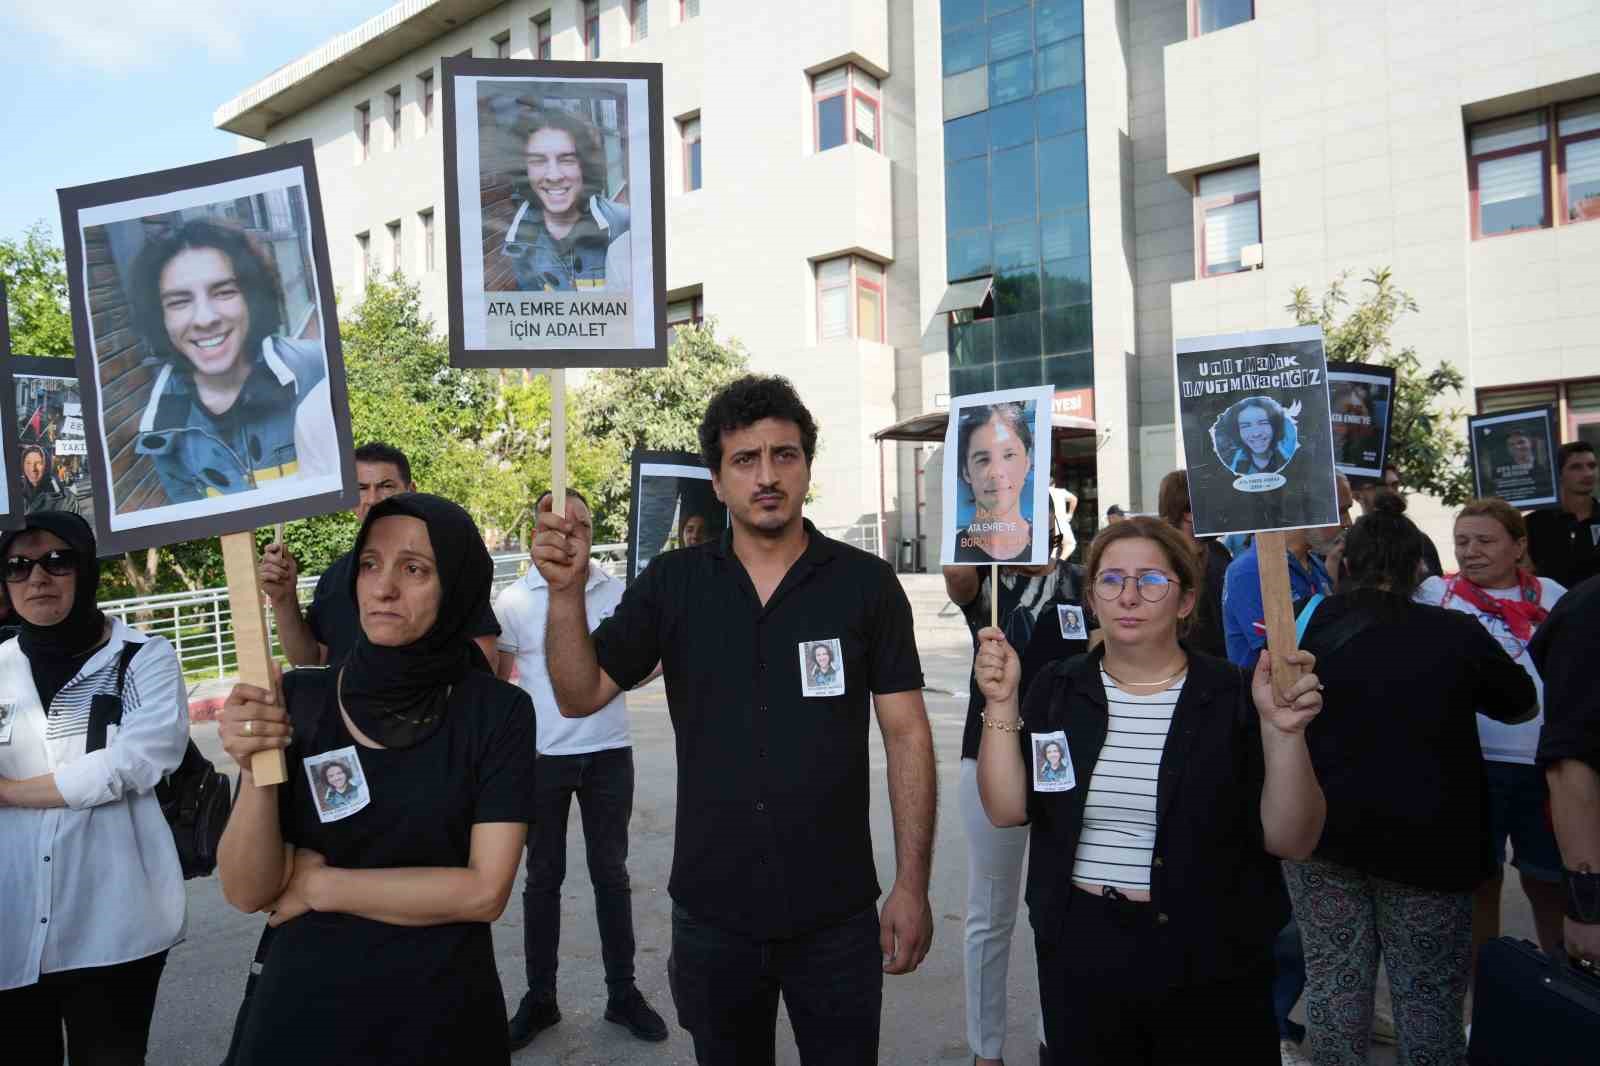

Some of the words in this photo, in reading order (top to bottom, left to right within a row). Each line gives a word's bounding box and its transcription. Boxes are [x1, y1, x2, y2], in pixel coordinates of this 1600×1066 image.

[487, 302, 516, 316] ATA
[520, 302, 565, 316] EMRE
[569, 302, 627, 316] AKMAN
[510, 320, 541, 340] İÇİN
[546, 322, 607, 337] ADALET
